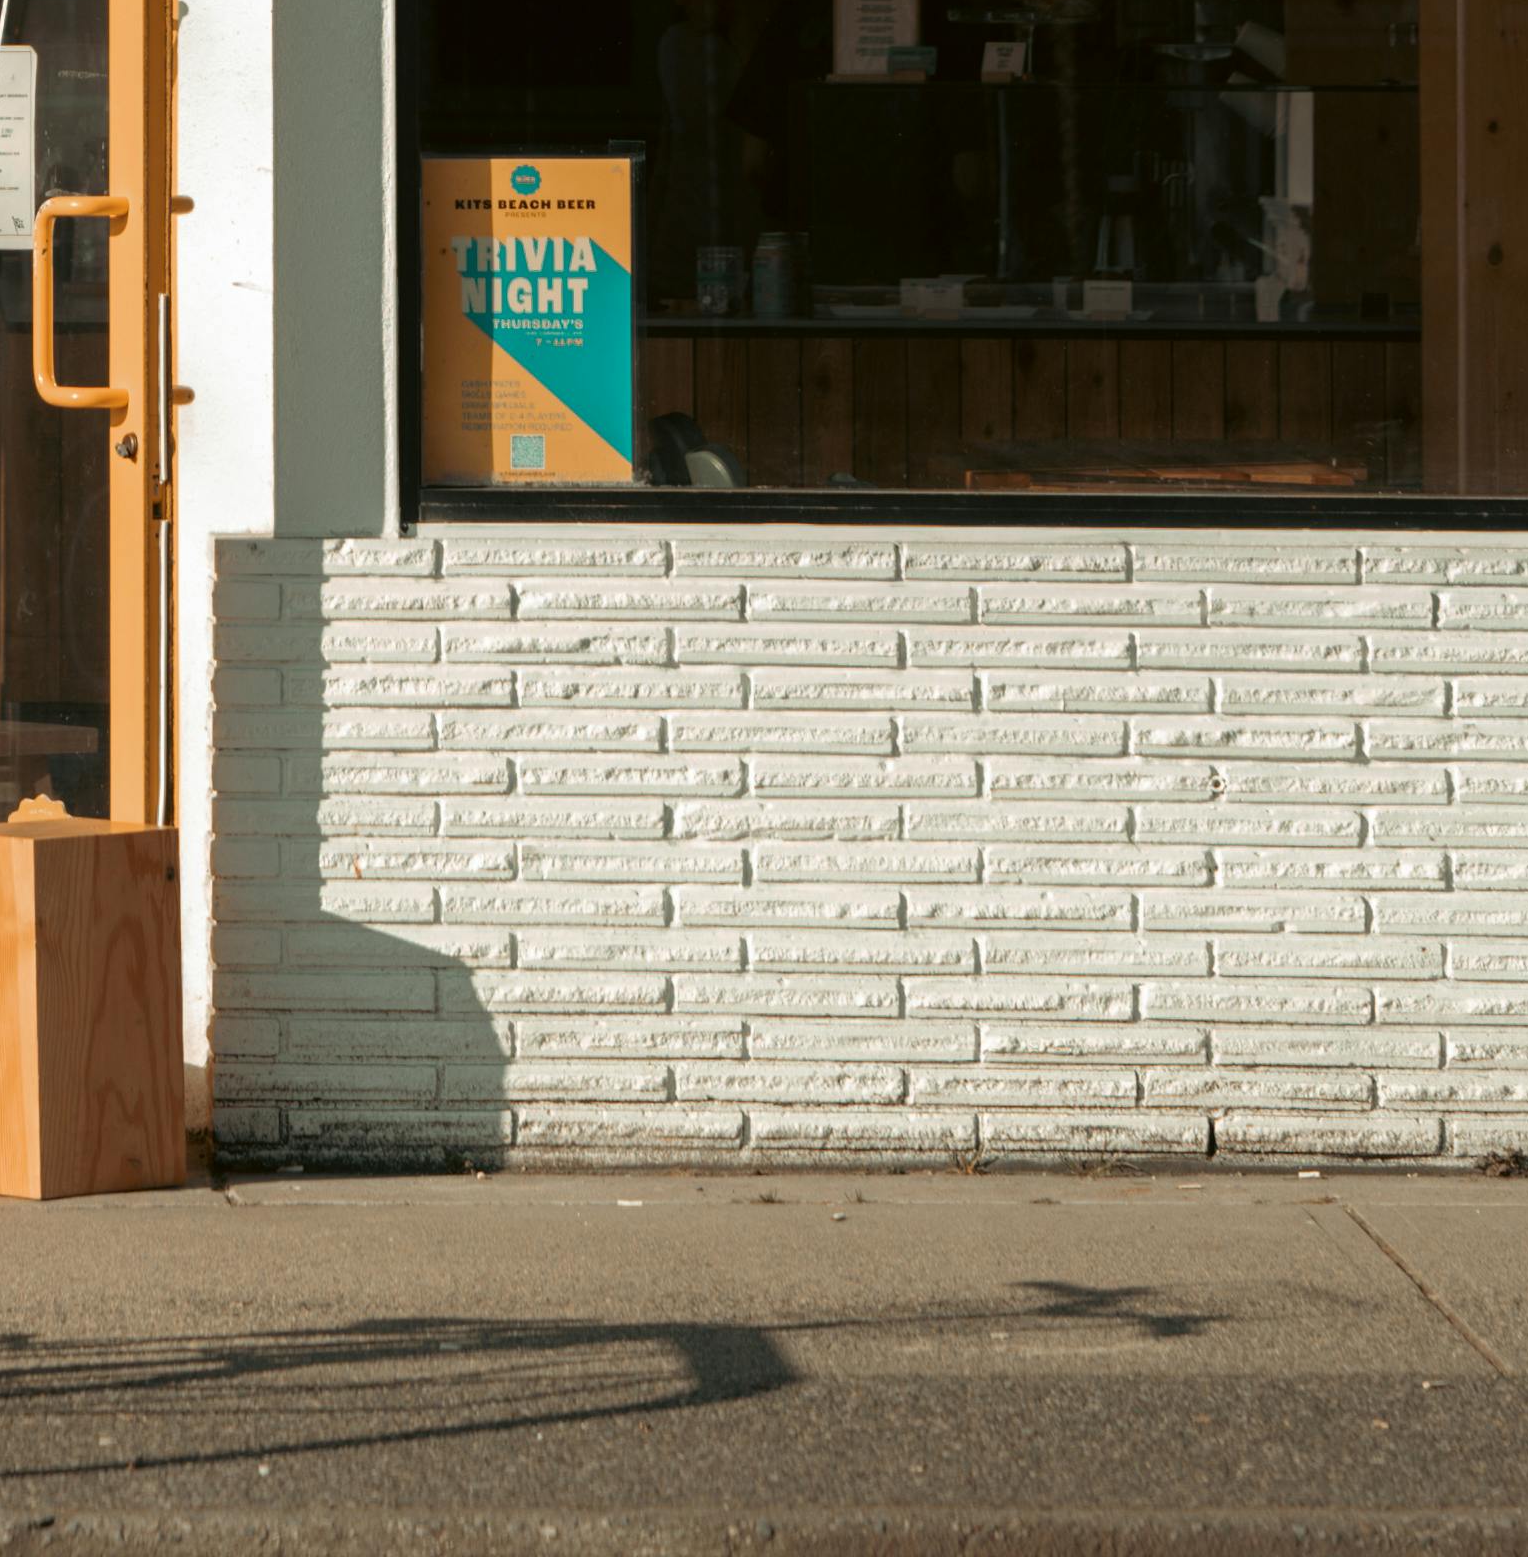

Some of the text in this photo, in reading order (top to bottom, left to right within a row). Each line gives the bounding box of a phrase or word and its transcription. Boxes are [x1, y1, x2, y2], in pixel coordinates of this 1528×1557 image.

[455, 199, 596, 209] KITS BEACH BEER
[451, 236, 597, 272] TRIVIA
[461, 277, 589, 314] NIGHT
[493, 318, 584, 329] THURSDAY'S
